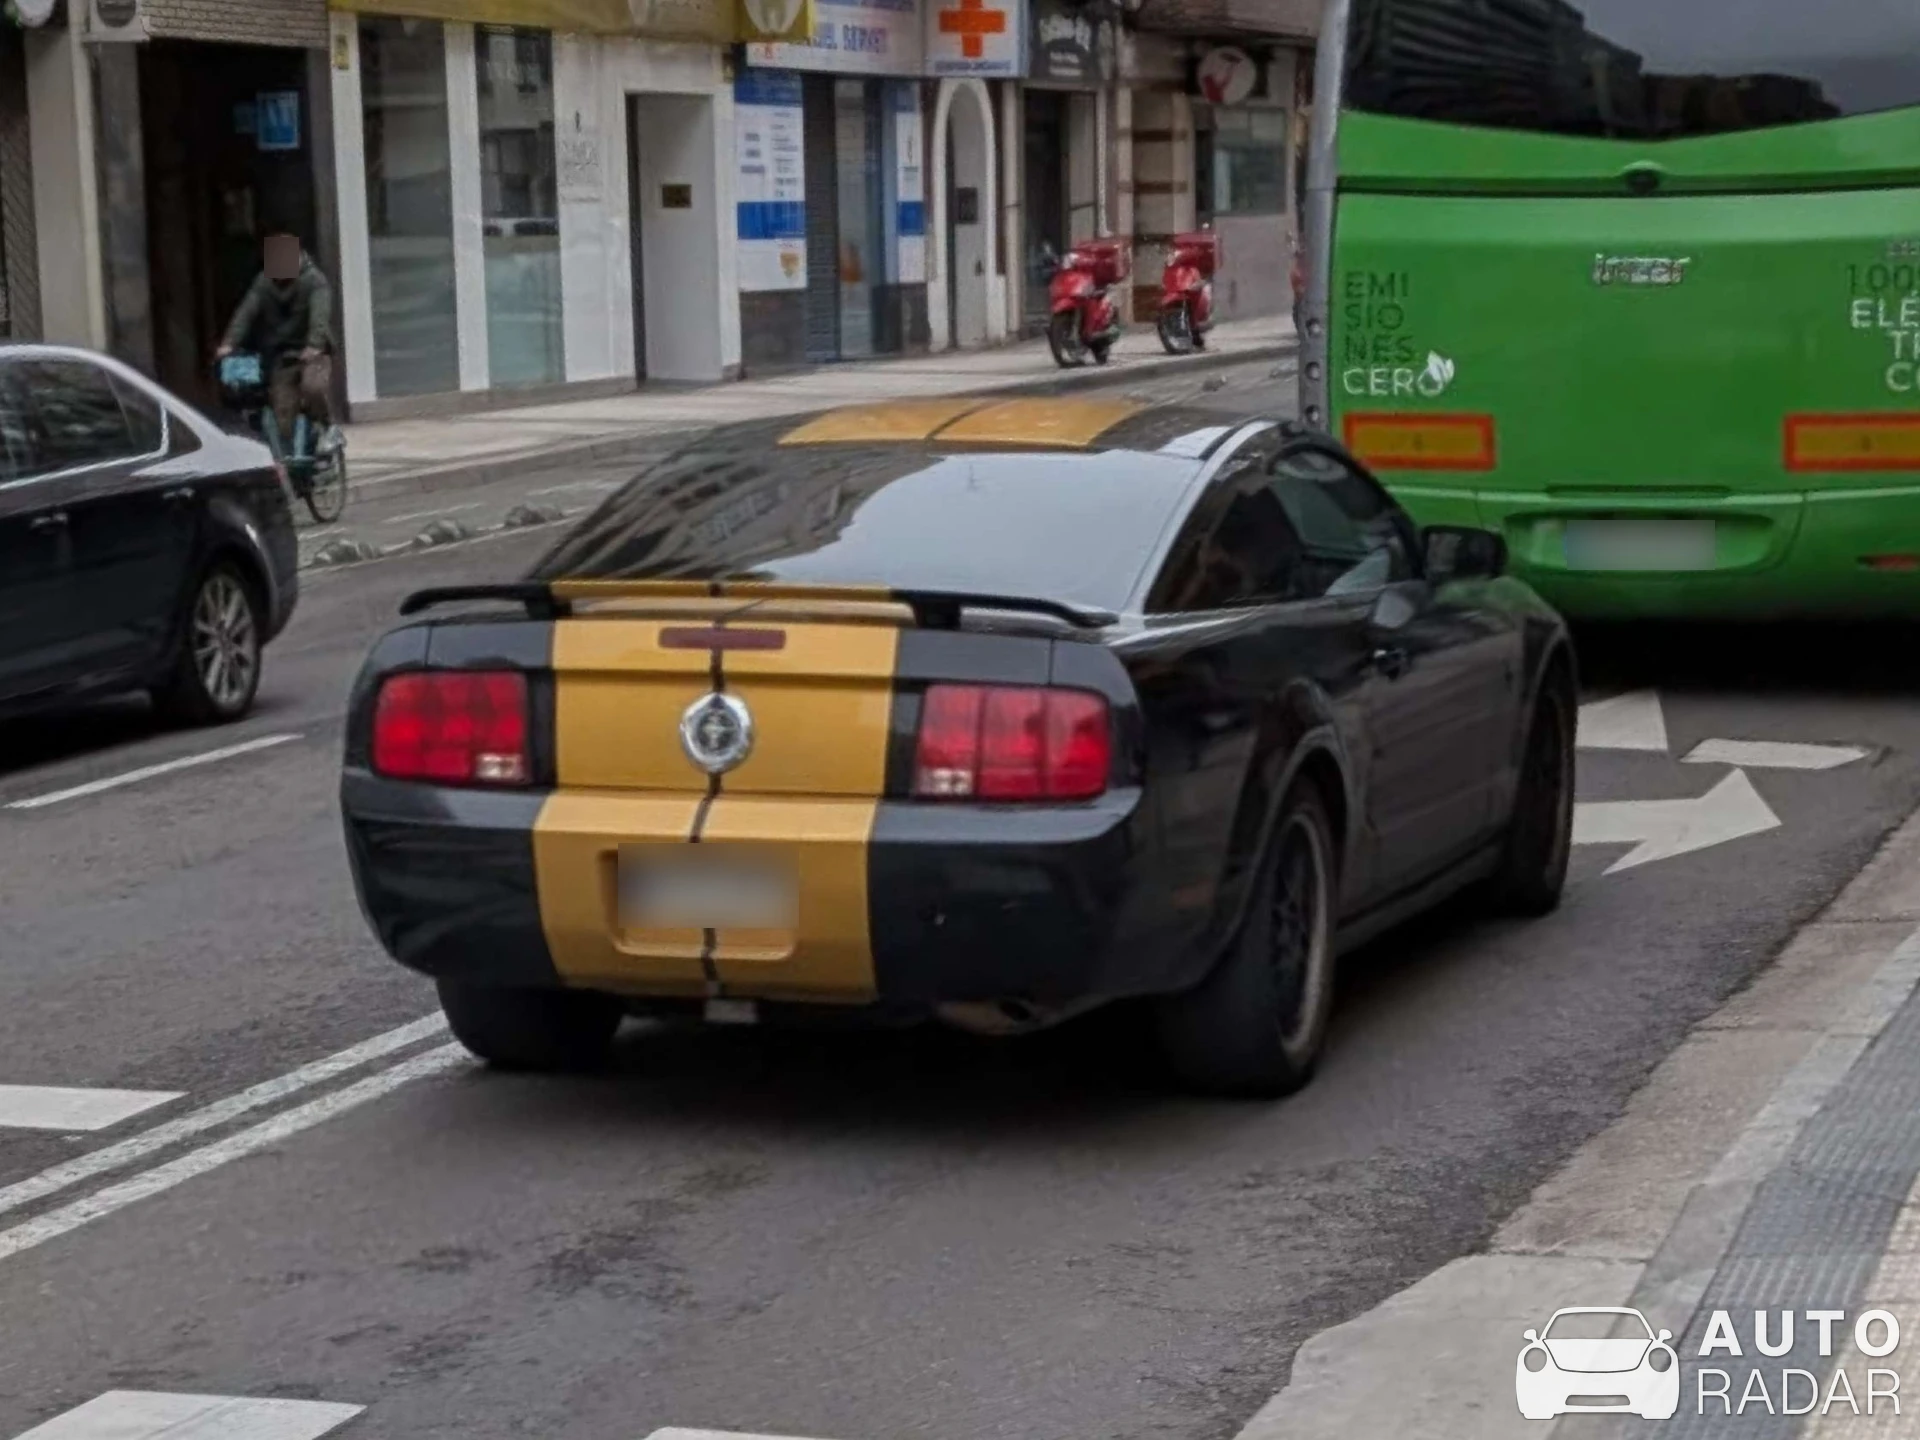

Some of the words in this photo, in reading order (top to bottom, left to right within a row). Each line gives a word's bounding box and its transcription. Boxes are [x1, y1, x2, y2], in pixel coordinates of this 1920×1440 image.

[1345, 272, 1408, 298] EMI
[1848, 264, 1920, 295] 100
[1345, 302, 1404, 330] SIO
[1345, 335, 1414, 362] NES
[1343, 366, 1445, 397] CERO
